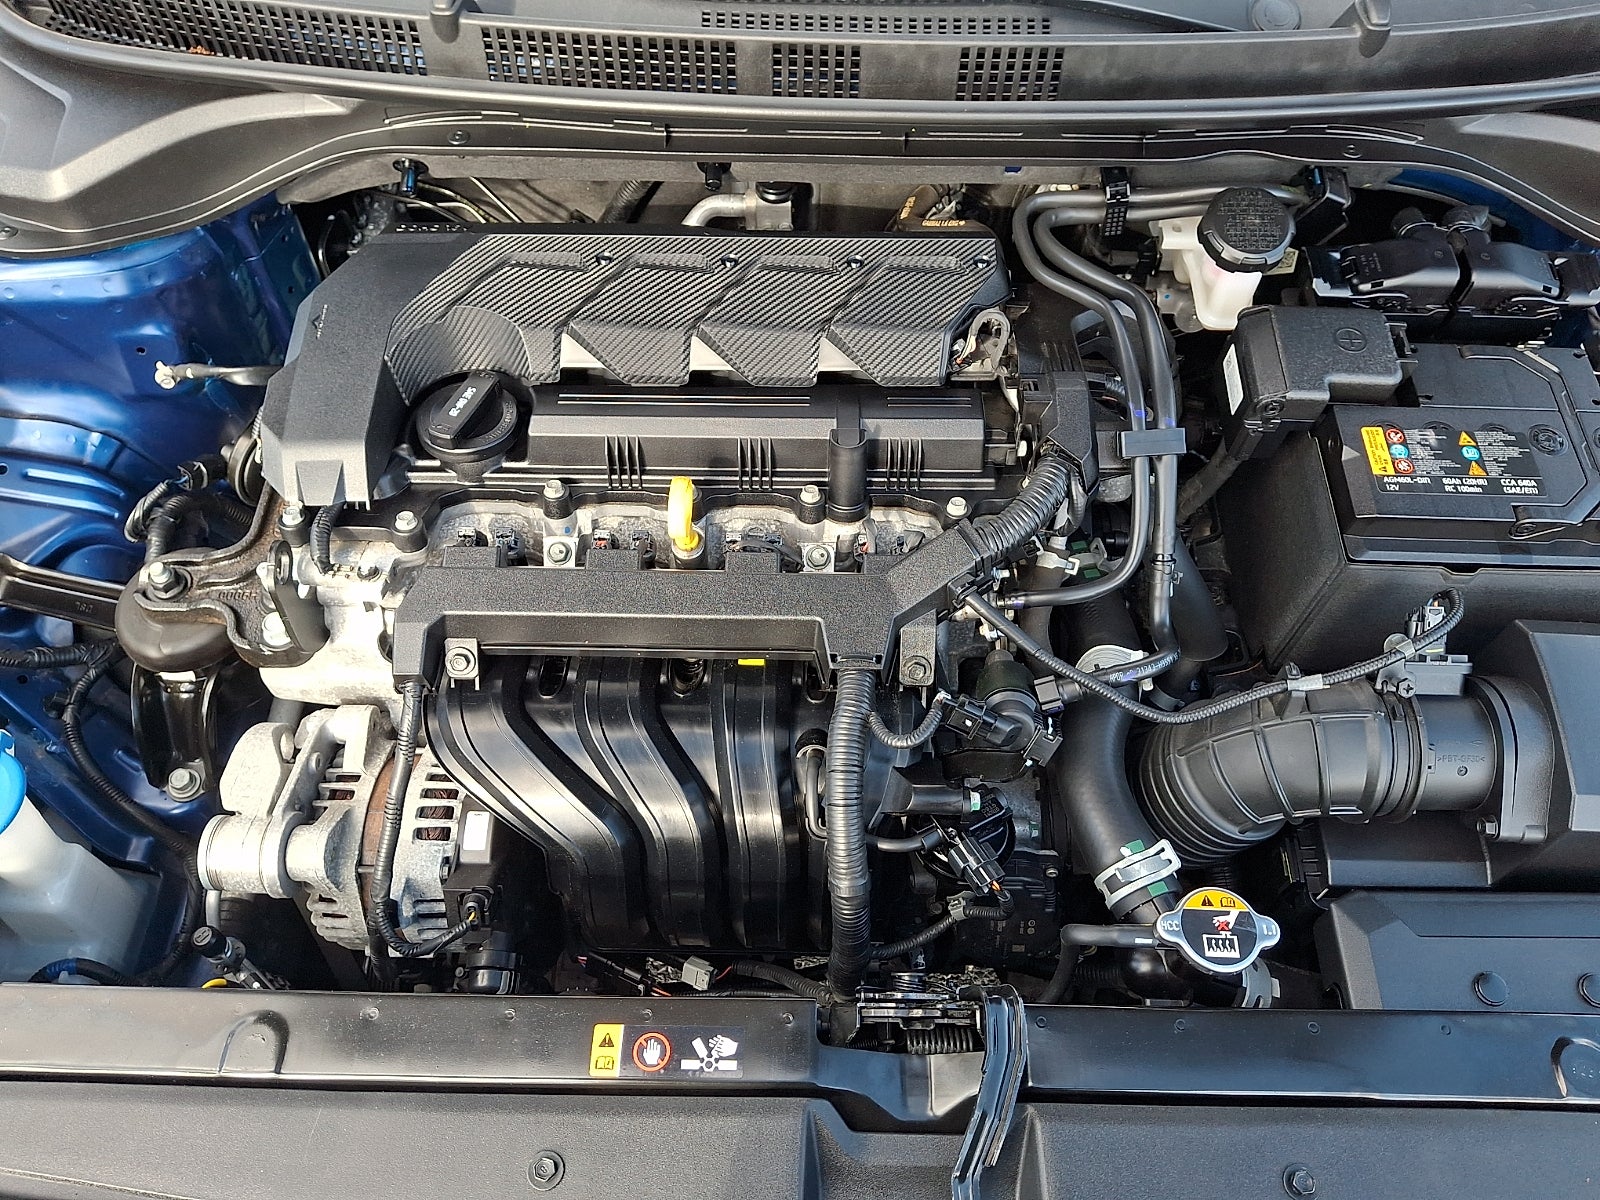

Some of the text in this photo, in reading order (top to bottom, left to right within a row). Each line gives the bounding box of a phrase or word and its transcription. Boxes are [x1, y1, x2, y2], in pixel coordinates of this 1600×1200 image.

[1384, 476, 1432, 484] AGM60L-DIN
[1442, 478, 1461, 486] 60Ah
[1161, 920, 1180, 931] HCC
[1262, 924, 1277, 936] 1.1
